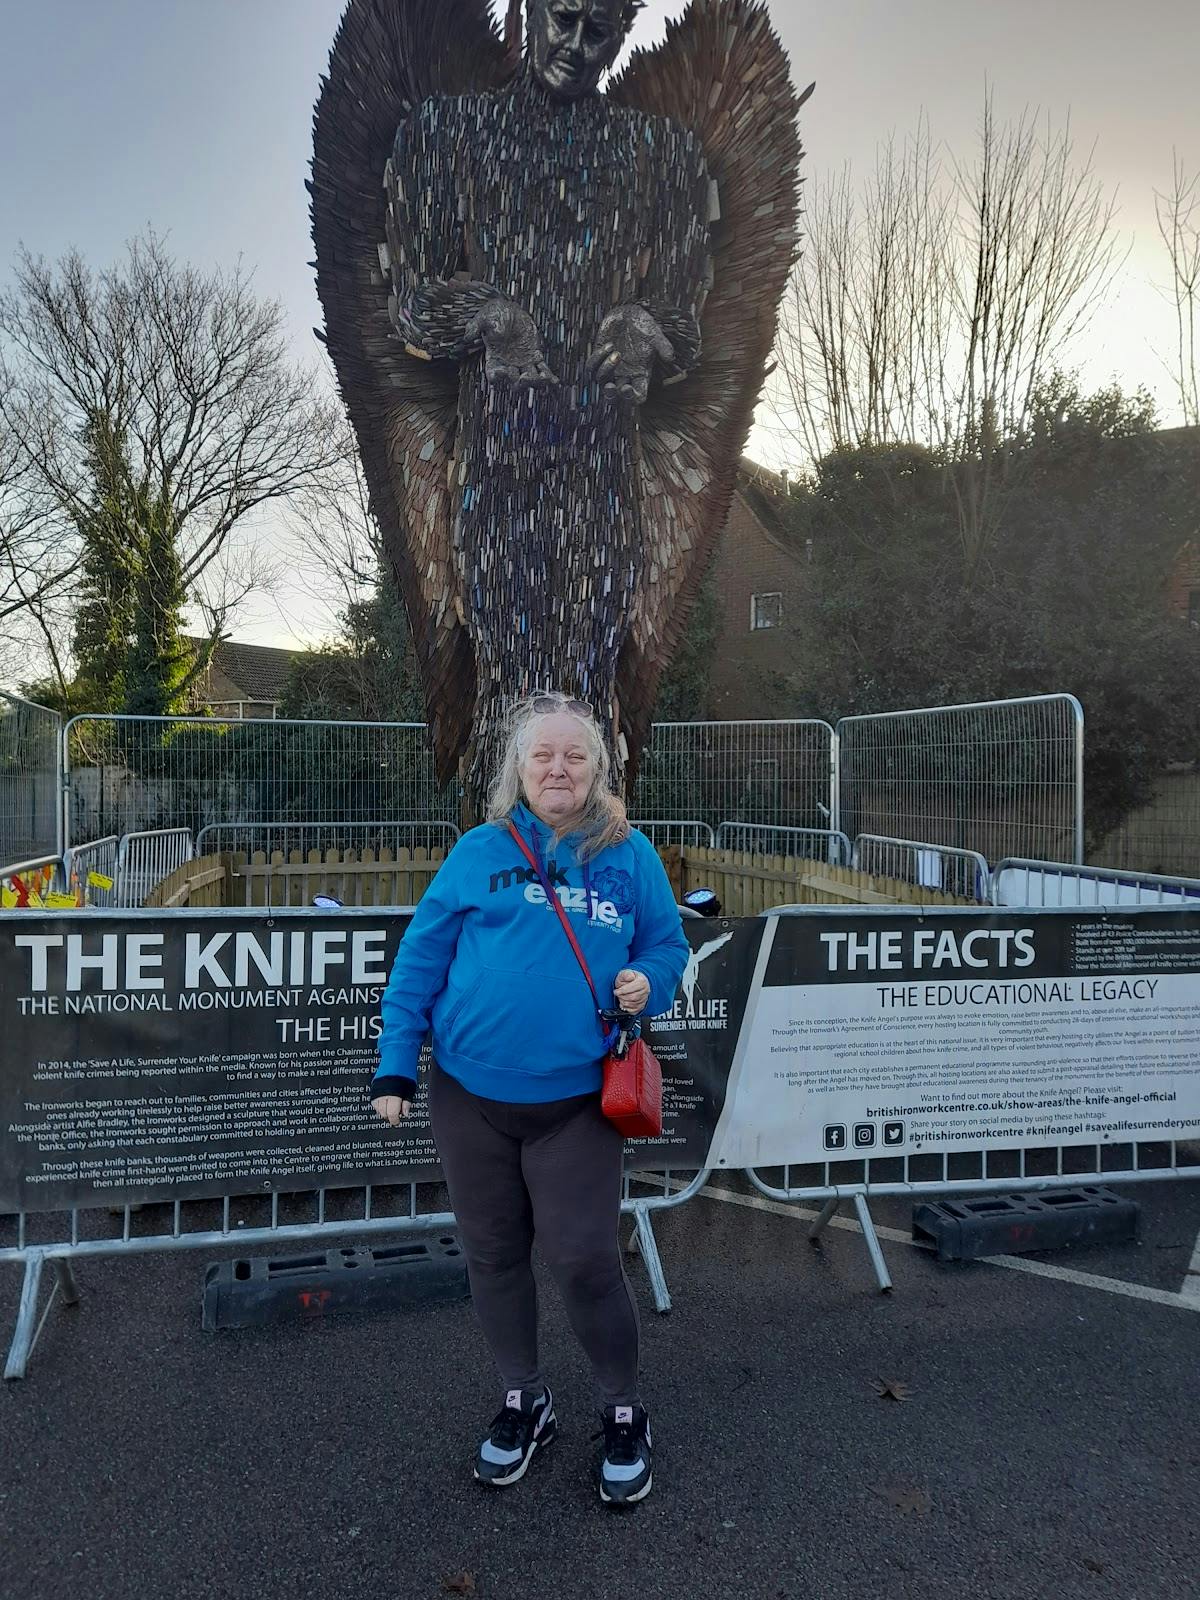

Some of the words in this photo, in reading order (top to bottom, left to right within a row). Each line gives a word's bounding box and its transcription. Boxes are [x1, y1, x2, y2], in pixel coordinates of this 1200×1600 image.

[15, 933, 165, 992] THE
[184, 930, 388, 989] KNIFE
[819, 931, 903, 972] THE
[912, 929, 1036, 969] FACTS
[17, 996, 59, 1017] THE
[65, 992, 172, 1015] NATIONAL
[178, 989, 304, 1012] MONUMENT
[876, 986, 918, 1009] THE
[925, 981, 1074, 1007] EDUCATIONAL
[1080, 979, 1159, 1003] LEGACY
[698, 999, 728, 1018] LIFE
[276, 1019, 330, 1044] THE
[650, 1020, 687, 1032] SURRENDER
[688, 1020, 707, 1030] YOUR
[707, 1019, 728, 1030] KNIFE
[652, 1044, 678, 1052] amount
[679, 1043, 685, 1051] of
[33, 1071, 62, 1081] violent
[63, 1070, 85, 1080] knife
[86, 1070, 114, 1079] crimes
[116, 1068, 139, 1078] being
[141, 1066, 176, 1078] reported
[178, 1065, 204, 1074] within
[205, 1064, 219, 1073] the
[220, 1063, 247, 1072] media.
[249, 1062, 276, 1071] Known
[278, 1061, 289, 1069] for
[290, 1060, 301, 1069] his
[303, 1058, 332, 1070] passion
[333, 1057, 348, 1066] and
[38, 1061, 46, 1070] In
[47, 1060, 71, 1071] 2014,
[72, 1060, 86, 1069] the
[88, 1059, 109, 1068] 'Save
[111, 1058, 117, 1067] A
[119, 1057, 136, 1068] Life,
[137, 1056, 177, 1066] Surrender
[178, 1055, 197, 1064] Your
[198, 1053, 220, 1063] Knife'
[222, 1052, 260, 1063] campaign
[278, 1051, 298, 1059] born
[299, 1050, 321, 1059] when
[322, 1049, 335, 1058] the
[336, 1048, 372, 1057] Chairman
[227, 1073, 235, 1082] to
[236, 1072, 252, 1081] find
[259, 1072, 276, 1081] way
[277, 1070, 286, 1079] to
[287, 1069, 308, 1078] make
[316, 1067, 330, 1077] real
[331, 1066, 369, 1076] difference
[674, 1078, 694, 1086] loved
[671, 1093, 705, 1103] alongside
[921, 1094, 940, 1102] Want
[941, 1094, 950, 1102] to
[951, 1093, 965, 1101] find
[966, 1092, 979, 1101] out
[1001, 1090, 1025, 1099] about
[1026, 1090, 1038, 1098] the
[1039, 1089, 1057, 1097] Knife
[1058, 1087, 1082, 1098] Angel?
[1083, 1087, 1105, 1095] Please
[1107, 1085, 1122, 1094] visit:
[679, 1102, 697, 1110] knife
[866, 1092, 1176, 1119] britishironworkcentre.co.uk/show-areas/the-knife-angel-official
[909, 1128, 1023, 1143] #britishironworkcentre
[1026, 1123, 1083, 1136] #knifeangel
[1085, 1118, 1200, 1132] #savealifesurrenderyour
[911, 1120, 929, 1129] Share
[930, 1121, 948, 1129] your
[949, 1118, 967, 1128] story
[979, 1116, 999, 1125] social
[1000, 1115, 1023, 1124] media
[1024, 1115, 1033, 1124] by
[1034, 1114, 1053, 1123] using
[1054, 1113, 1072, 1121] these
[647, 1136, 670, 1145] blades
[670, 1137, 687, 1145] were
[42, 1161, 78, 1172] Through
[79, 1160, 103, 1169] these
[104, 1158, 125, 1167] knife
[126, 1156, 153, 1166] banks,
[154, 1153, 196, 1164] thousands
[198, 1152, 206, 1161] of
[208, 1151, 244, 1161] weapons
[245, 1150, 265, 1158] were
[266, 1145, 303, 1156] collected,
[304, 1143, 334, 1154] cleaned
[335, 1142, 350, 1152] and
[351, 1140, 383, 1151] blunted,
[384, 1139, 405, 1149] ready
[406, 1138, 414, 1147] to
[415, 1138, 433, 1147] form
[93, 1179, 112, 1188] then
[114, 1177, 124, 1187] all
[125, 1174, 174, 1186] strategically
[175, 1172, 203, 1184] placed
[204, 1171, 213, 1180] to
[214, 1171, 234, 1180] form
[235, 1169, 248, 1178] the
[250, 1167, 270, 1177] Knife
[271, 1165, 294, 1177] Angel
[295, 1164, 315, 1175] itself,
[317, 1163, 341, 1174] giving
[342, 1162, 354, 1171] life
[355, 1161, 363, 1170] to
[364, 1159, 384, 1169] what
[385, 1159, 391, 1168] is
[409, 1157, 434, 1166] known
